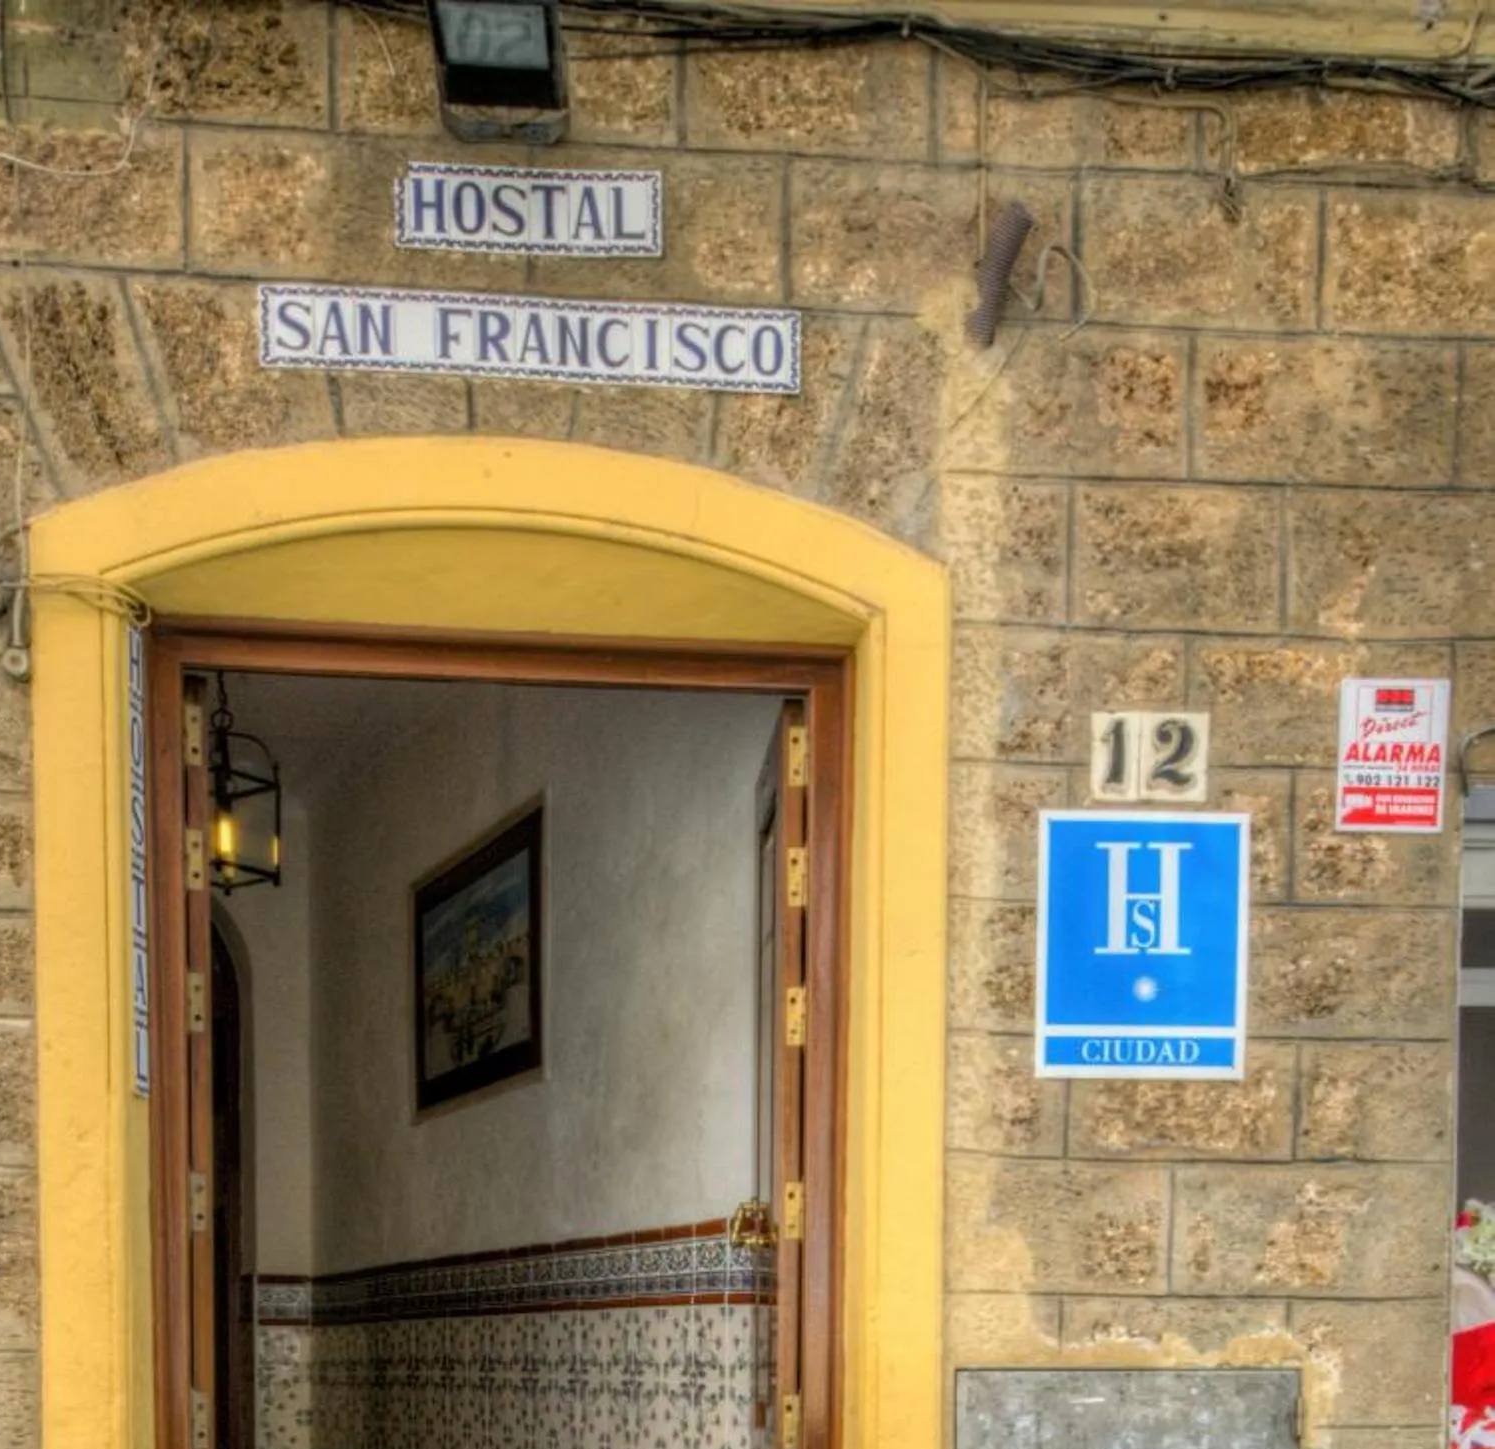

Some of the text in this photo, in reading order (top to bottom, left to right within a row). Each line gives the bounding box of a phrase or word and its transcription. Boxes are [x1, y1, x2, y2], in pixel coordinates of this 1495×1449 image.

[411, 178, 646, 241] HOSTAL
[276, 300, 785, 378] SAN FRANCISCO
[1101, 717, 1197, 796] 12
[1343, 742, 1441, 762] ALARMA
[1356, 773, 1441, 787] 902 121 122
[129, 630, 150, 1082] HOSTAL
[1081, 1039, 1201, 1064] CIUDAD
